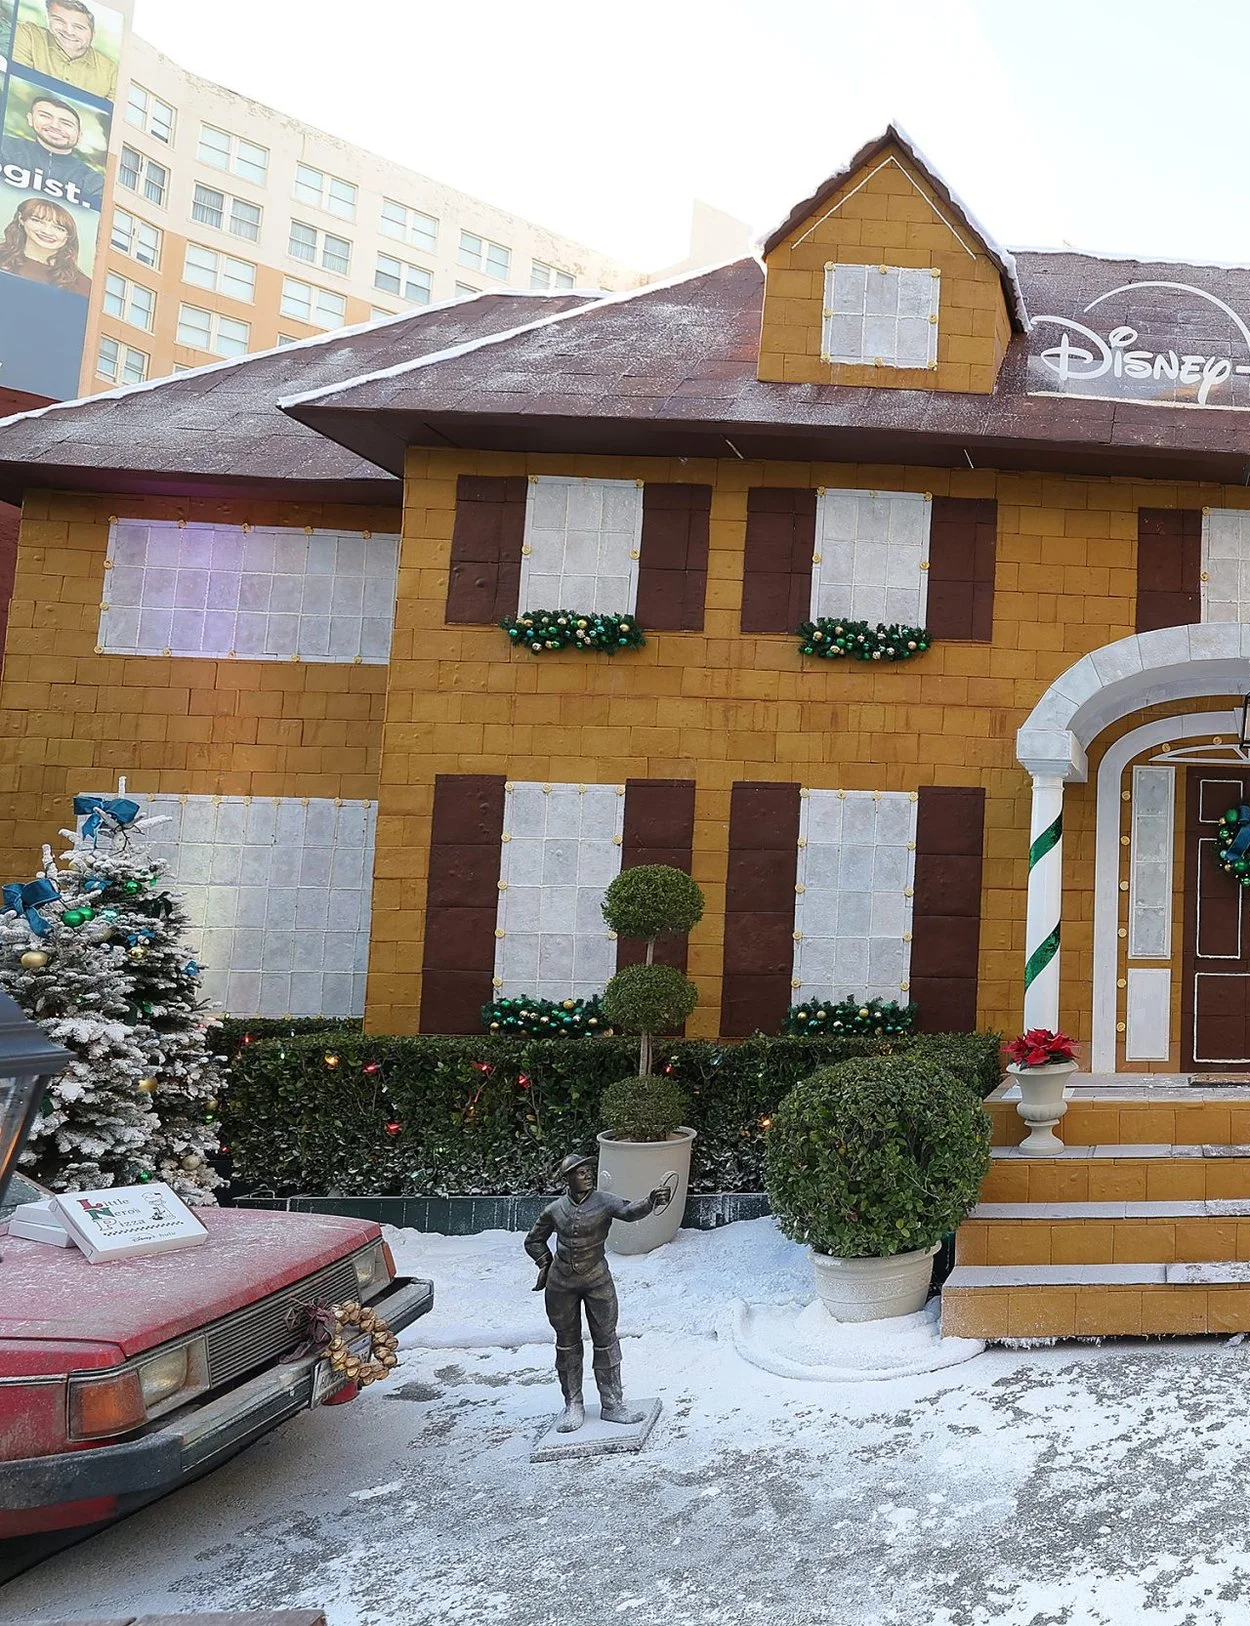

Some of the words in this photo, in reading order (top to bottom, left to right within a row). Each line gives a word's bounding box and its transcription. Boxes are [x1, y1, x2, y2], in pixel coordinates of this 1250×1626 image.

[76, 1198, 129, 1210] Little
[84, 1206, 141, 1220] Nero's
[92, 1217, 146, 1232] Pizza
